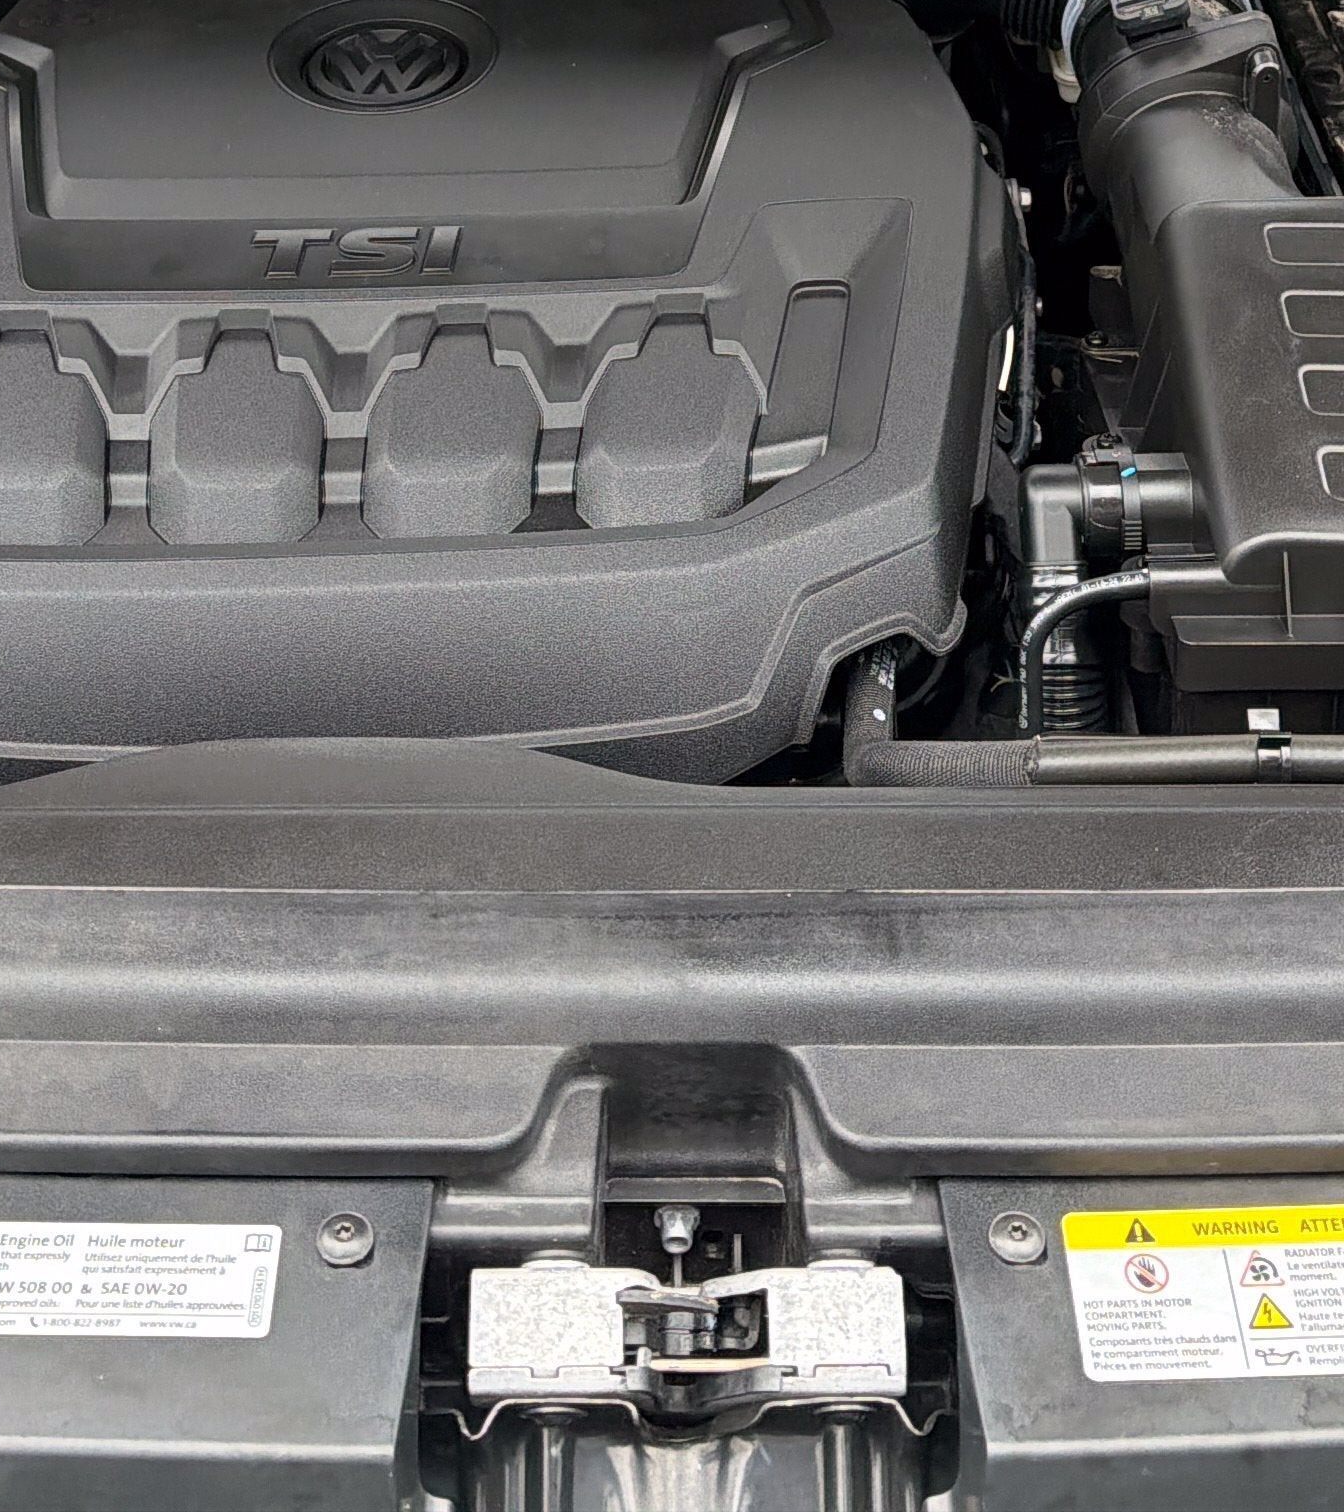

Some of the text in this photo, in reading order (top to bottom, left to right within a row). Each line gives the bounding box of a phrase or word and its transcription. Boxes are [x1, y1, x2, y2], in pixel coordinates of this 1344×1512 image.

[250, 225, 465, 280] TSI
[1191, 1218, 1279, 1237] WARNING
[0, 1234, 75, 1249] Engine Oil
[88, 1235, 185, 1248] Huile moteur
[1, 1250, 22, 1260] that
[24, 1251, 71, 1263] expressly
[1285, 1248, 1334, 1257] RADIATOR
[85, 1253, 122, 1263] Utilisez
[125, 1254, 188, 1264] uniquement
[190, 1254, 202, 1263] de
[82, 1265, 226, 1276] qui satisfait expressément à
[1287, 1262, 1299, 1270] Le
[18, 1281, 47, 1294] 508
[52, 1281, 73, 1294] 00
[81, 1284, 92, 1294] &
[101, 1282, 130, 1295] SAE
[135, 1283, 188, 1295] 0W-20
[1294, 1289, 1319, 1297] HIGH
[75, 1299, 99, 1309] Pour
[101, 1301, 120, 1309] une
[123, 1299, 143, 1309] liste
[1083, 1298, 1192, 1309] HOT PARTS IN MOTOR
[1296, 1299, 1342, 1308] IGNITION
[1085, 1310, 1167, 1320] COMPARTMENT.
[1299, 1312, 1330, 1321] Haute
[140, 1320, 197, 1328] www.vw.ca
[1087, 1322, 1129, 1331] MOVING
[1089, 1334, 1237, 1347] Composants très chauds dans
[1091, 1350, 1101, 1359] le
[1103, 1349, 1178, 1360] compartiment
[1094, 1361, 1126, 1371] Pièces
[1129, 1362, 1143, 1370] en
